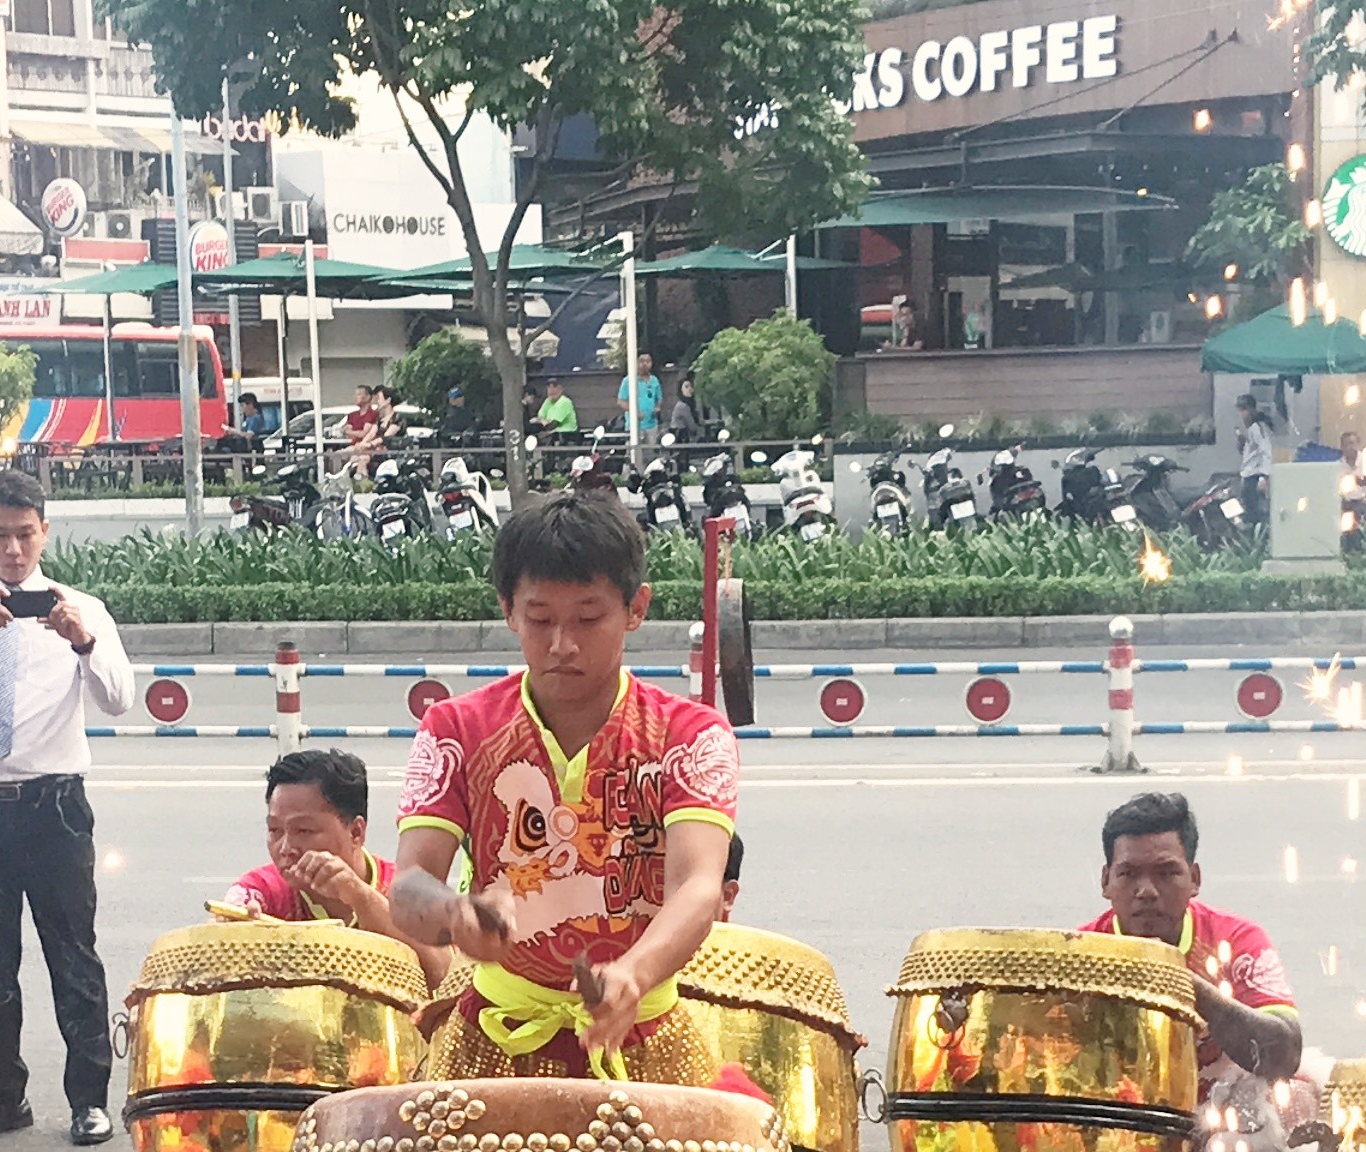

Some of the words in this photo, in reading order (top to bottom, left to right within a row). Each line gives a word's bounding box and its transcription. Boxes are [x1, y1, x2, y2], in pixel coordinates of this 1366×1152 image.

[912, 15, 1118, 101] COFFEE
[50, 194, 74, 226] KING
[196, 240, 227, 255] BURGE
[24, 299, 51, 318] LAN
